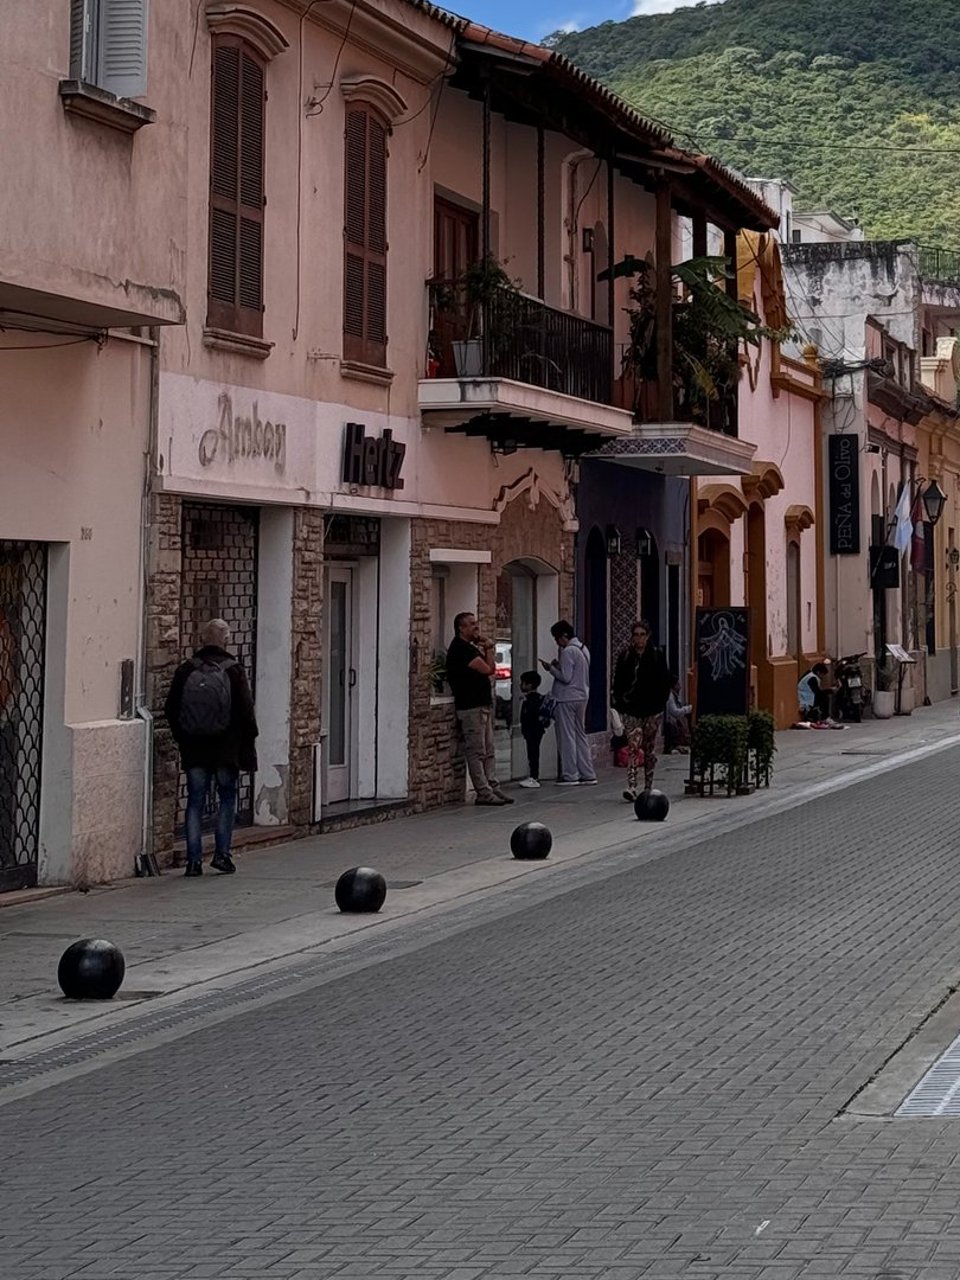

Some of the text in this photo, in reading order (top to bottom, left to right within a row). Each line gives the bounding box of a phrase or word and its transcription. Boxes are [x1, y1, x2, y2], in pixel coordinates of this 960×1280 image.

[343, 422, 406, 490] Hertz
[834, 438, 852, 549] PEÑA del Olivo
